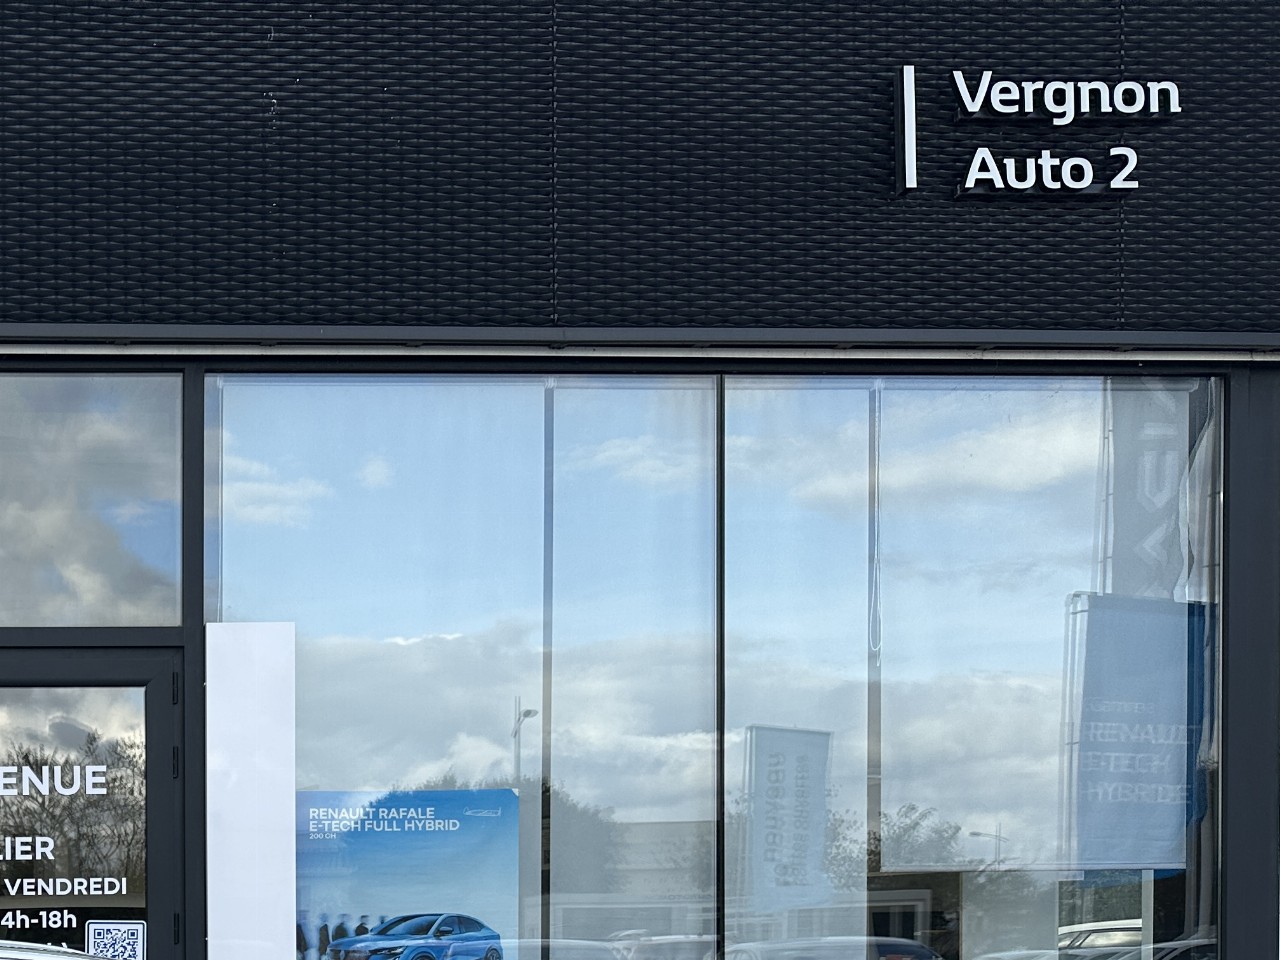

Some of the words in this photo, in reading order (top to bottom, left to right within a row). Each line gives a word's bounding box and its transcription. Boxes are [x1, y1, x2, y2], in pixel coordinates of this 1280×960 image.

[952, 70, 1182, 126] Vergnon
[964, 147, 1093, 190] Auto
[1109, 147, 1140, 190] 2
[309, 807, 376, 820] RENAULT
[378, 807, 435, 819] RAFALE
[309, 820, 361, 832] E-TECH
[364, 820, 401, 832] FULL
[404, 819, 460, 831] HYBRID
[4, 877, 127, 896] VENDREDI
